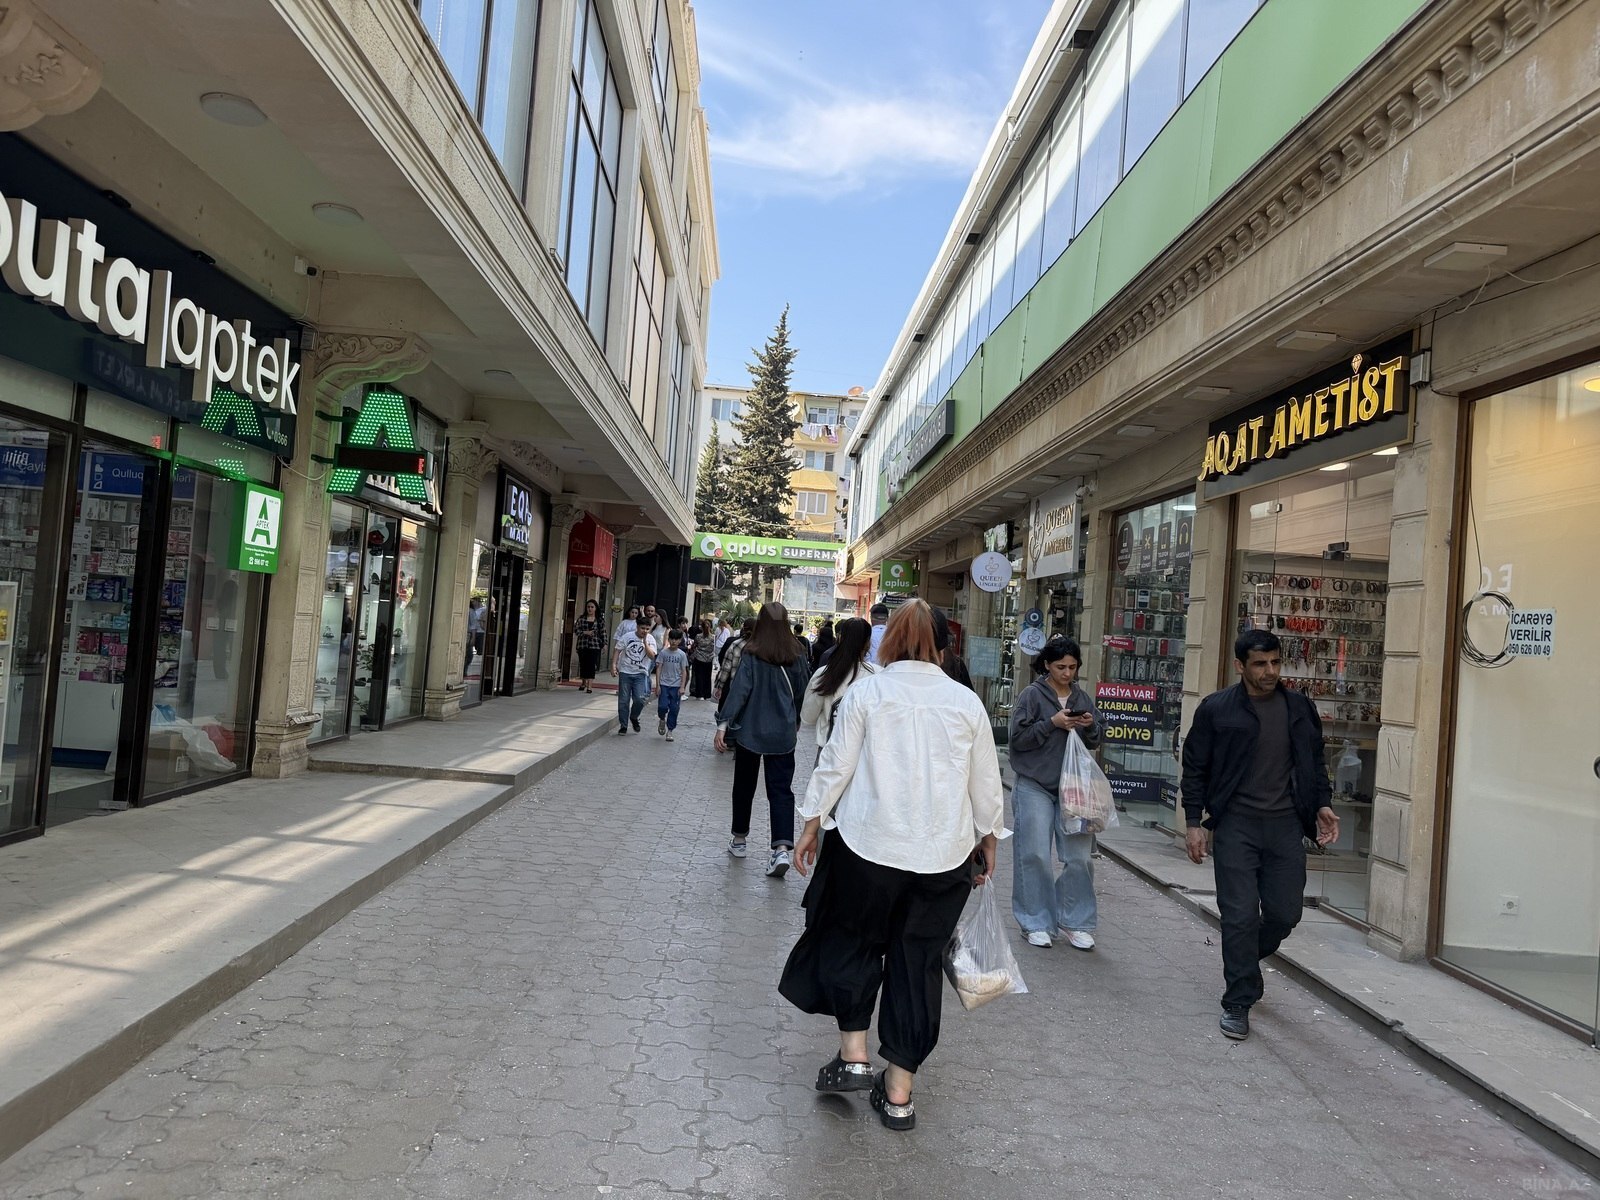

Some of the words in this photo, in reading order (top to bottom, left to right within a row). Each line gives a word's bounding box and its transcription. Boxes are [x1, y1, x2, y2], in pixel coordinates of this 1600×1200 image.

[171, 297, 301, 415] aptek
[1264, 354, 1403, 460] AMETİST
[112, 467, 143, 481] Qulluq
[172, 471, 190, 483] ləri
[256, 520, 270, 530] APTEK
[1046, 503, 1075, 536] QUEEN
[509, 526, 530, 545] MALL
[728, 539, 777, 557] aplus
[885, 579, 910, 589] aplus
[980, 574, 1003, 582] QUEEN
[1511, 610, 1553, 625] İCARƏYƏ
[1510, 627, 1552, 642] VERİLİR
[1508, 643, 1519, 654] 050
[1520, 643, 1532, 655] 626
[1533, 644, 1541, 655] 00
[1542, 644, 1551, 656] 49
[1098, 685, 1131, 697] AKSİYA
[1133, 689, 1154, 699] VAR!
[1098, 701, 1103, 710] 2
[1103, 701, 1139, 712] KABURA
[1142, 704, 1153, 713] AL
[1119, 713, 1148, 722] Qoruyucu
[1105, 724, 1151, 741] ƏDİYYƏ
